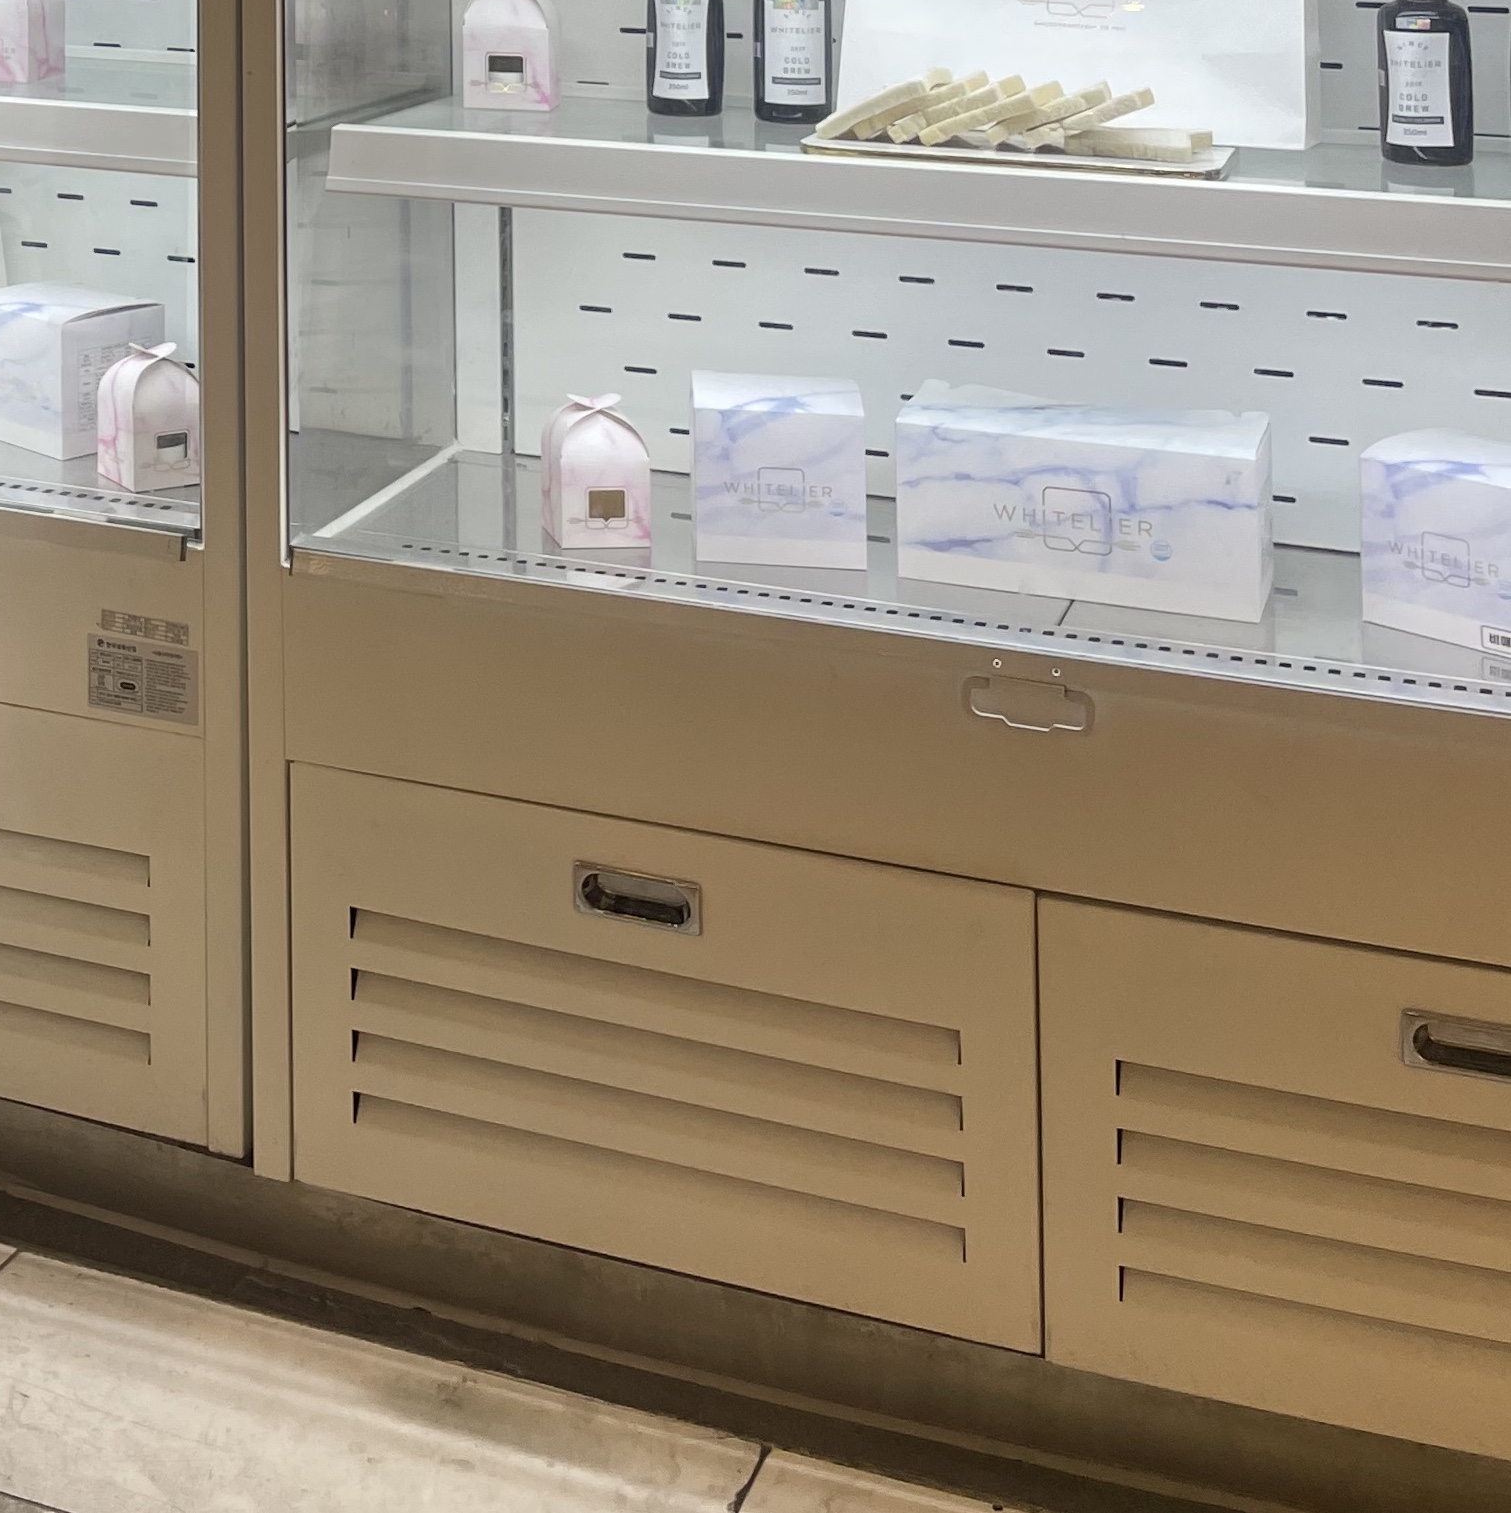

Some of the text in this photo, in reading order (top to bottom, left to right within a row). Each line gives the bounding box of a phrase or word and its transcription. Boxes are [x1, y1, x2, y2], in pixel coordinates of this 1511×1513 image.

[783, 56, 811, 65] COLD
[782, 66, 811, 75] BREW
[1398, 92, 1429, 102] COLD
[1397, 104, 1431, 113] BREW
[723, 480, 833, 498] WHITELIER
[993, 502, 1154, 538] WHITELIER
[1387, 539, 1500, 579] WHITELIER
